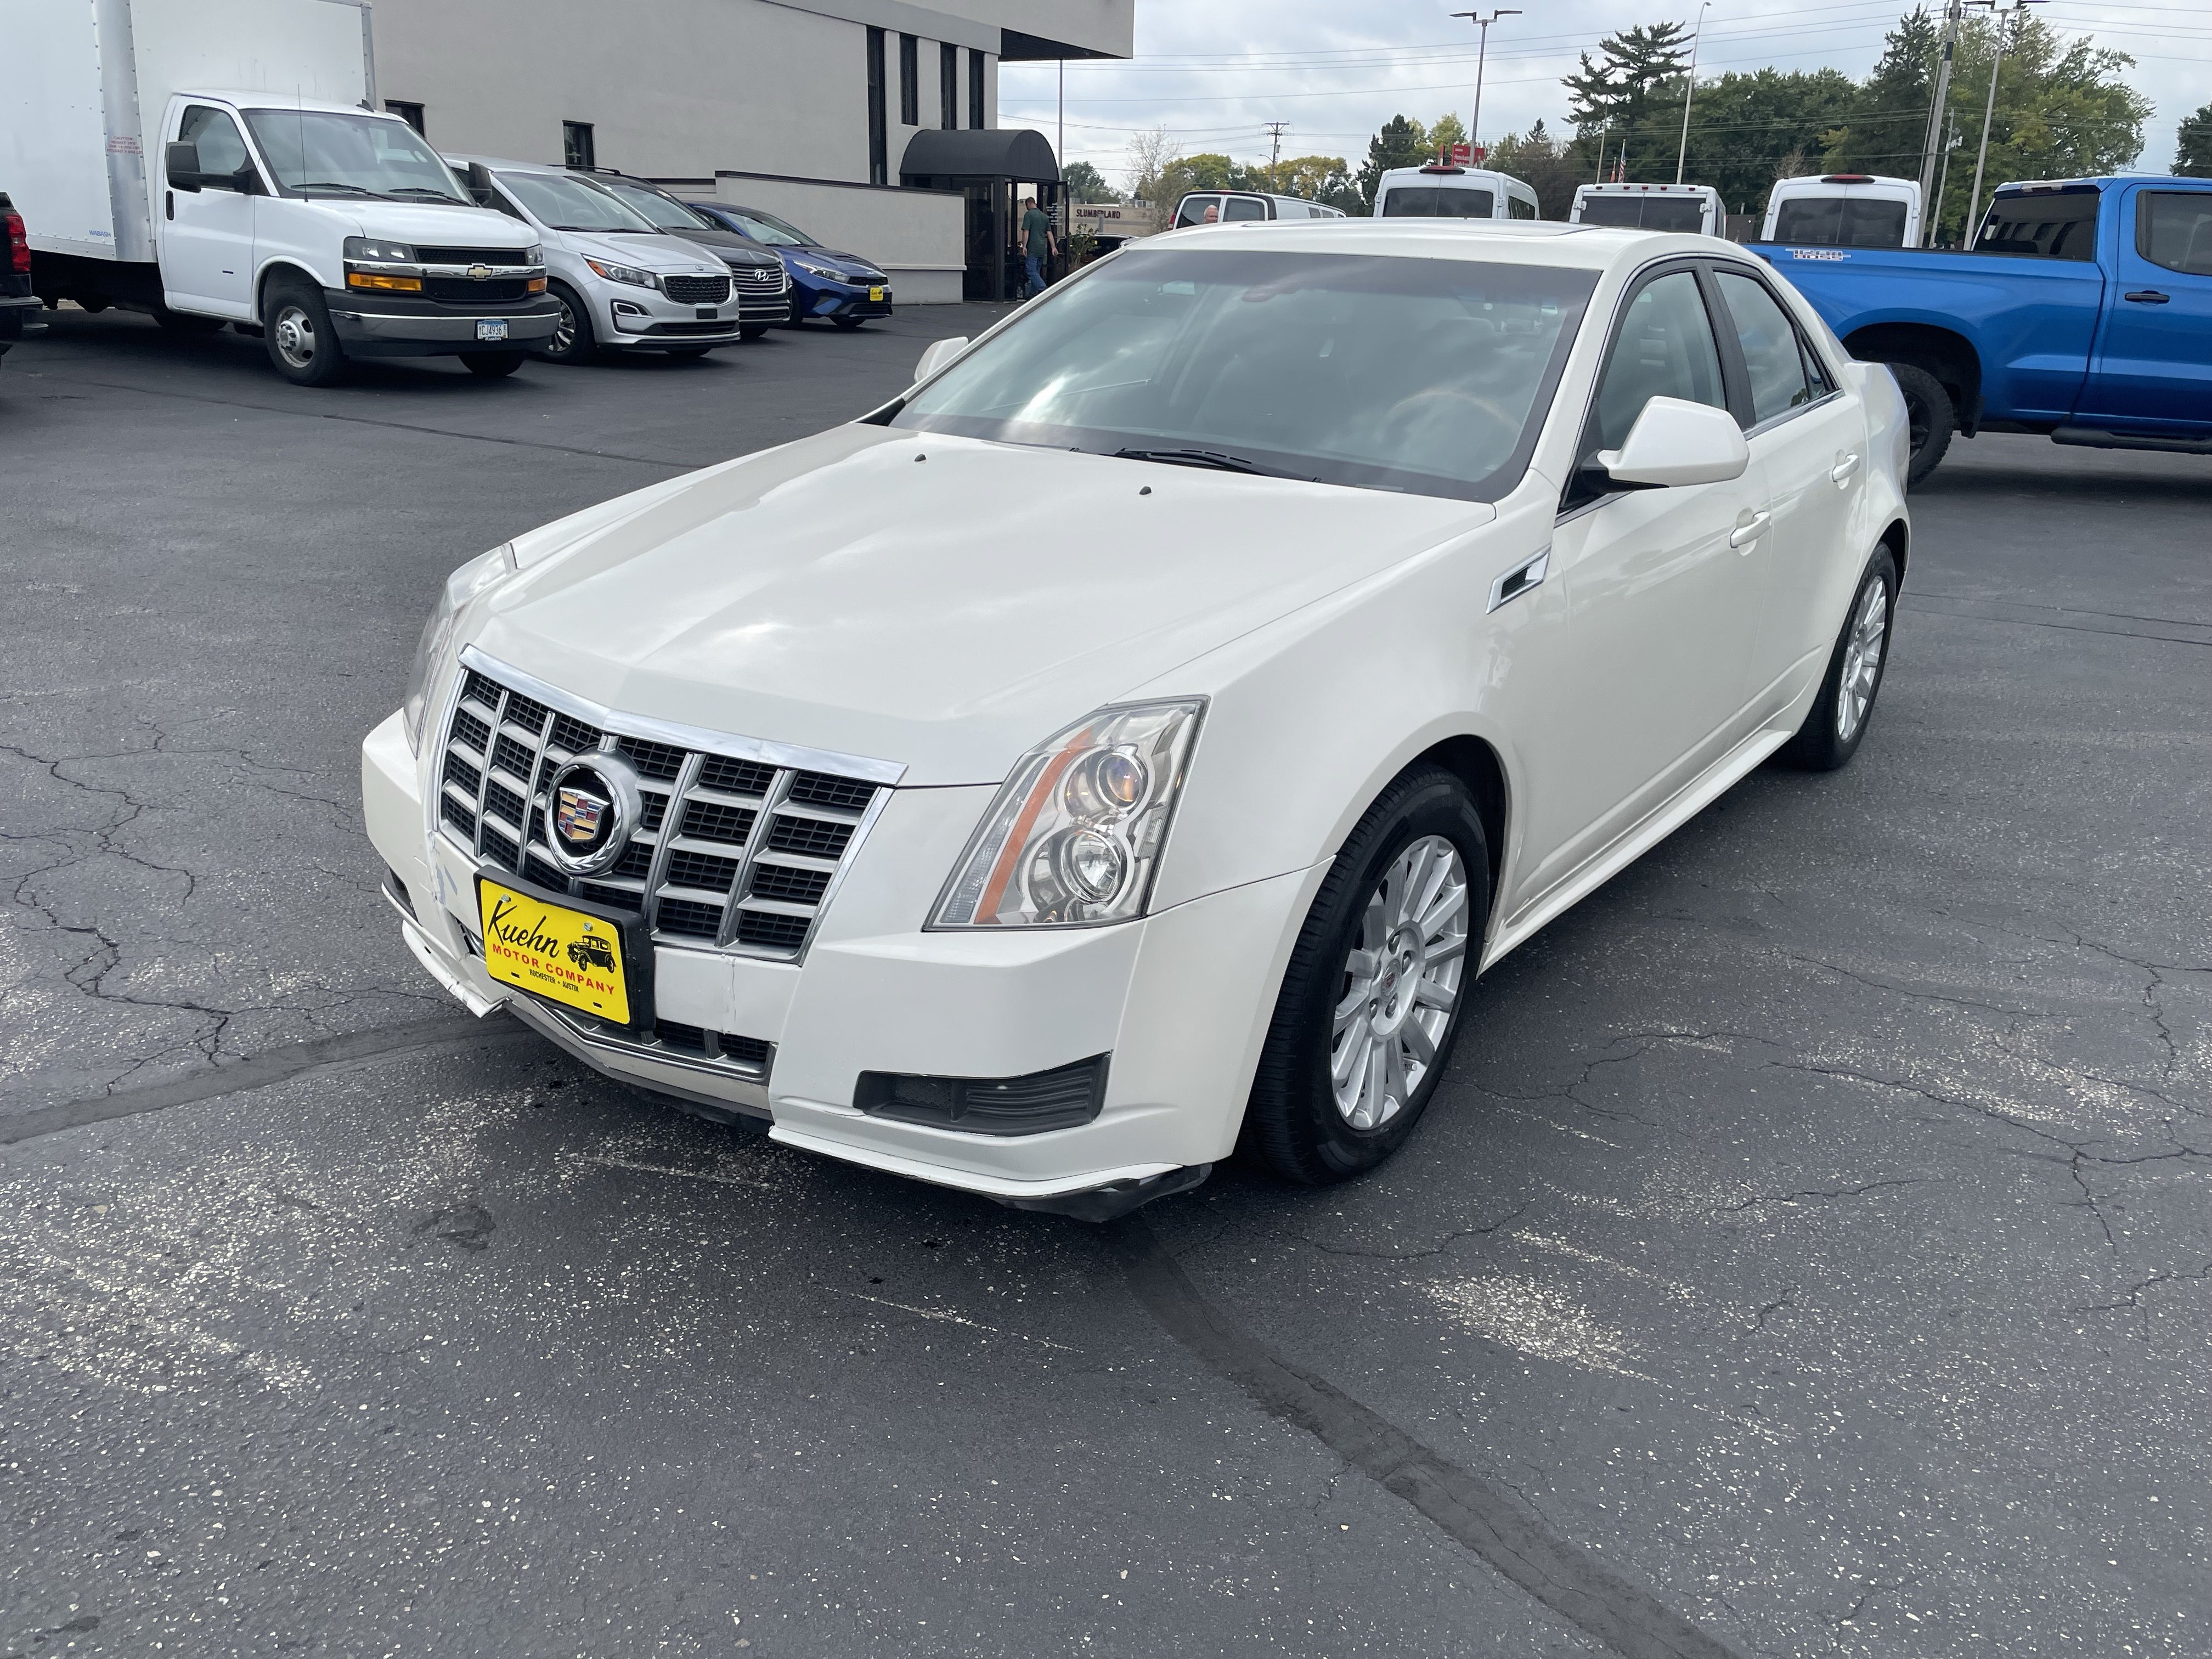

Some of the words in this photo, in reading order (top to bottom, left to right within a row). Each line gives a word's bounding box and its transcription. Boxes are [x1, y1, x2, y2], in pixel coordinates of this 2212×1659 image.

[478, 325, 502, 335] YCJ4936
[488, 900, 560, 958] Kuehn
[492, 943, 540, 969] MOTOR
[545, 963, 615, 995] COMPANY
[529, 968, 556, 984] ROCHESTER
